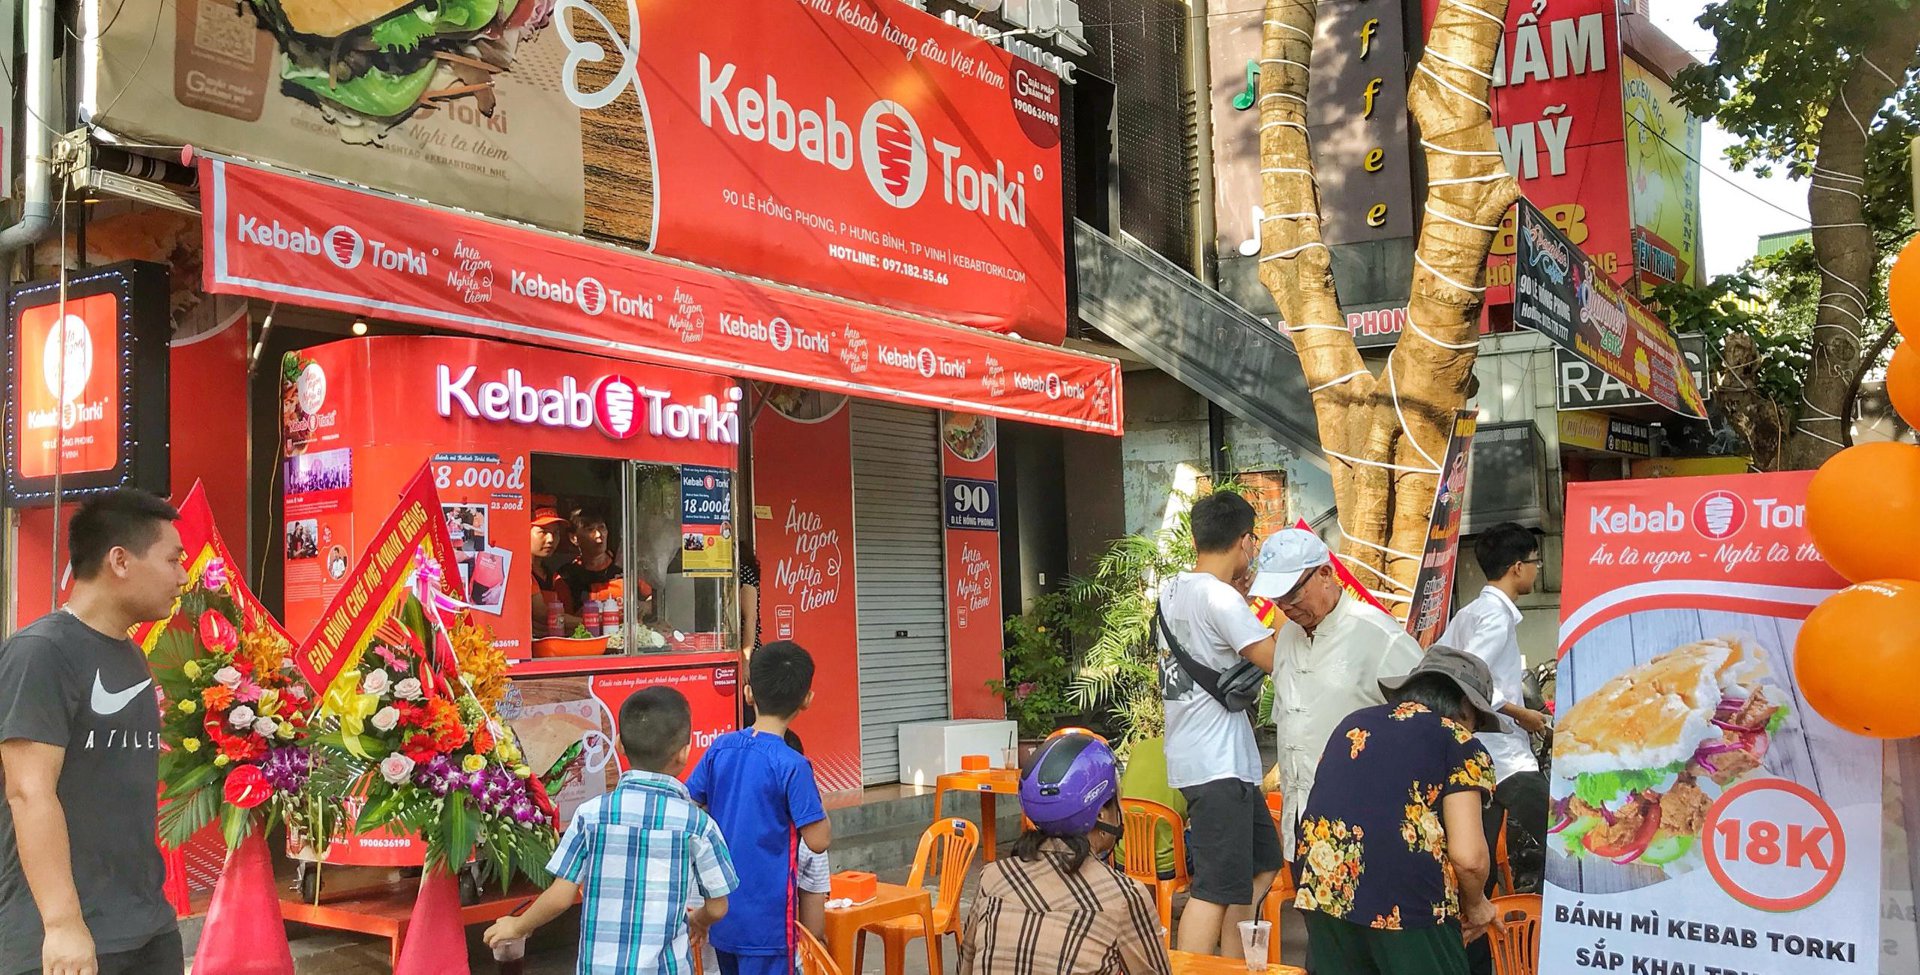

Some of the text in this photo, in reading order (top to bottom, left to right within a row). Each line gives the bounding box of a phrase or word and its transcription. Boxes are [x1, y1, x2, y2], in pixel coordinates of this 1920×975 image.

[835, 0, 878, 35] Kebab
[881, 19, 918, 61] hàng
[921, 37, 947, 65] đầu
[950, 47, 974, 78] Việt
[976, 61, 1005, 90] Nam
[1493, 0, 1606, 88] ẨM
[1013, 97, 1059, 126] 1900636198
[699, 52, 853, 171] Kebab
[932, 136, 1026, 228] Torki
[1494, 103, 1574, 180] MỸ
[238, 214, 428, 276] Kebab Torki
[722, 188, 738, 205] 90
[741, 191, 756, 211] LÊ
[757, 195, 792, 221] HỒNG
[795, 209, 838, 235] PHONG,
[849, 225, 880, 245] HƯNG
[910, 241, 922, 255] TP
[924, 245, 947, 263] VINH
[953, 252, 1027, 283] KEBABTORKI.COM
[829, 244, 949, 285] HOTLINE: 097.182.55.66
[511, 269, 654, 320] Kebab Torki
[719, 312, 829, 353] Kebab Torki
[1347, 307, 1408, 338] PHON
[878, 345, 966, 378] Kebab Torki
[1014, 371, 1045, 392] Kebab
[77, 402, 103, 422] Torki
[437, 364, 740, 445] Kebab Torki
[431, 456, 525, 489] 8.000đ
[683, 476, 703, 487] Kebab
[785, 498, 809, 535] Ăn
[953, 484, 990, 514] 90
[1589, 498, 1806, 534] Kebab Tor
[796, 529, 838, 562] ngon
[1589, 543, 1614, 566] Ăn
[1618, 546, 1639, 565] là
[1643, 550, 1692, 574] ngon
[1766, 541, 1790, 562] là
[307, 639, 334, 675] GIA
[376, 529, 405, 574] MINH
[800, 585, 838, 612] thèm
[359, 838, 411, 848] 1900636198
[1715, 818, 1833, 871] 18K
[1555, 900, 1856, 963] BÁNH MÌ KEBAB TORKI
[1576, 937, 1624, 971] SẮP
[1631, 955, 1697, 975] KHAI
